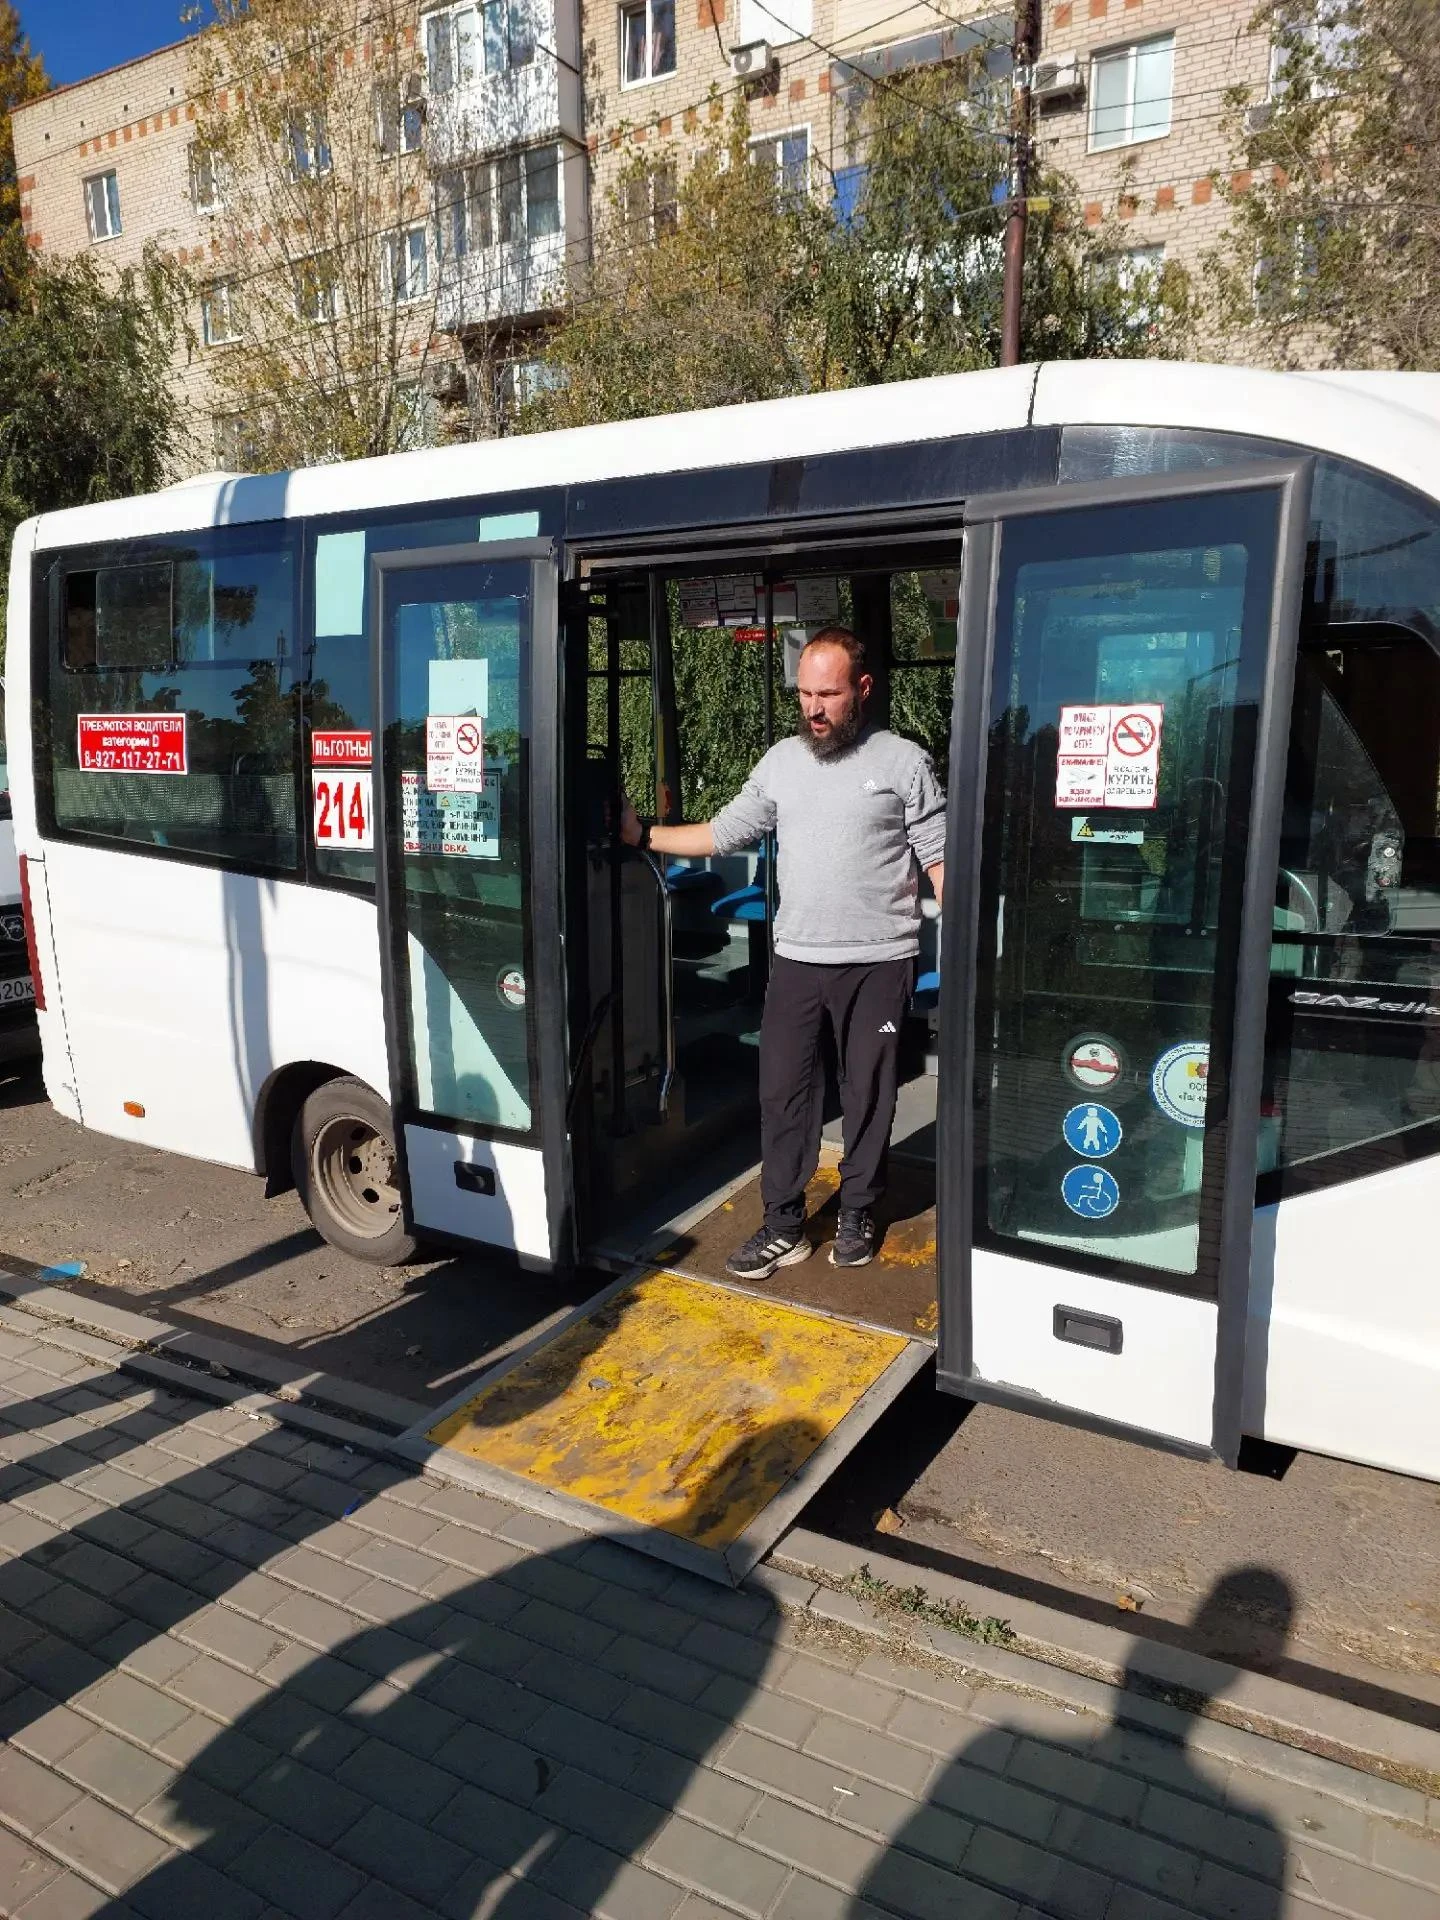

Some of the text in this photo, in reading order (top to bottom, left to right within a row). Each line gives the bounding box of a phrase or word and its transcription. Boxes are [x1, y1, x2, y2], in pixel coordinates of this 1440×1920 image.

[81, 720, 182, 733] ТРЕБУЮТСЯ ВОДИТЕЛИ
[102, 734, 160, 750] категории D
[1108, 774, 1154, 785] КУРИТЬ
[317, 782, 365, 839] 214
